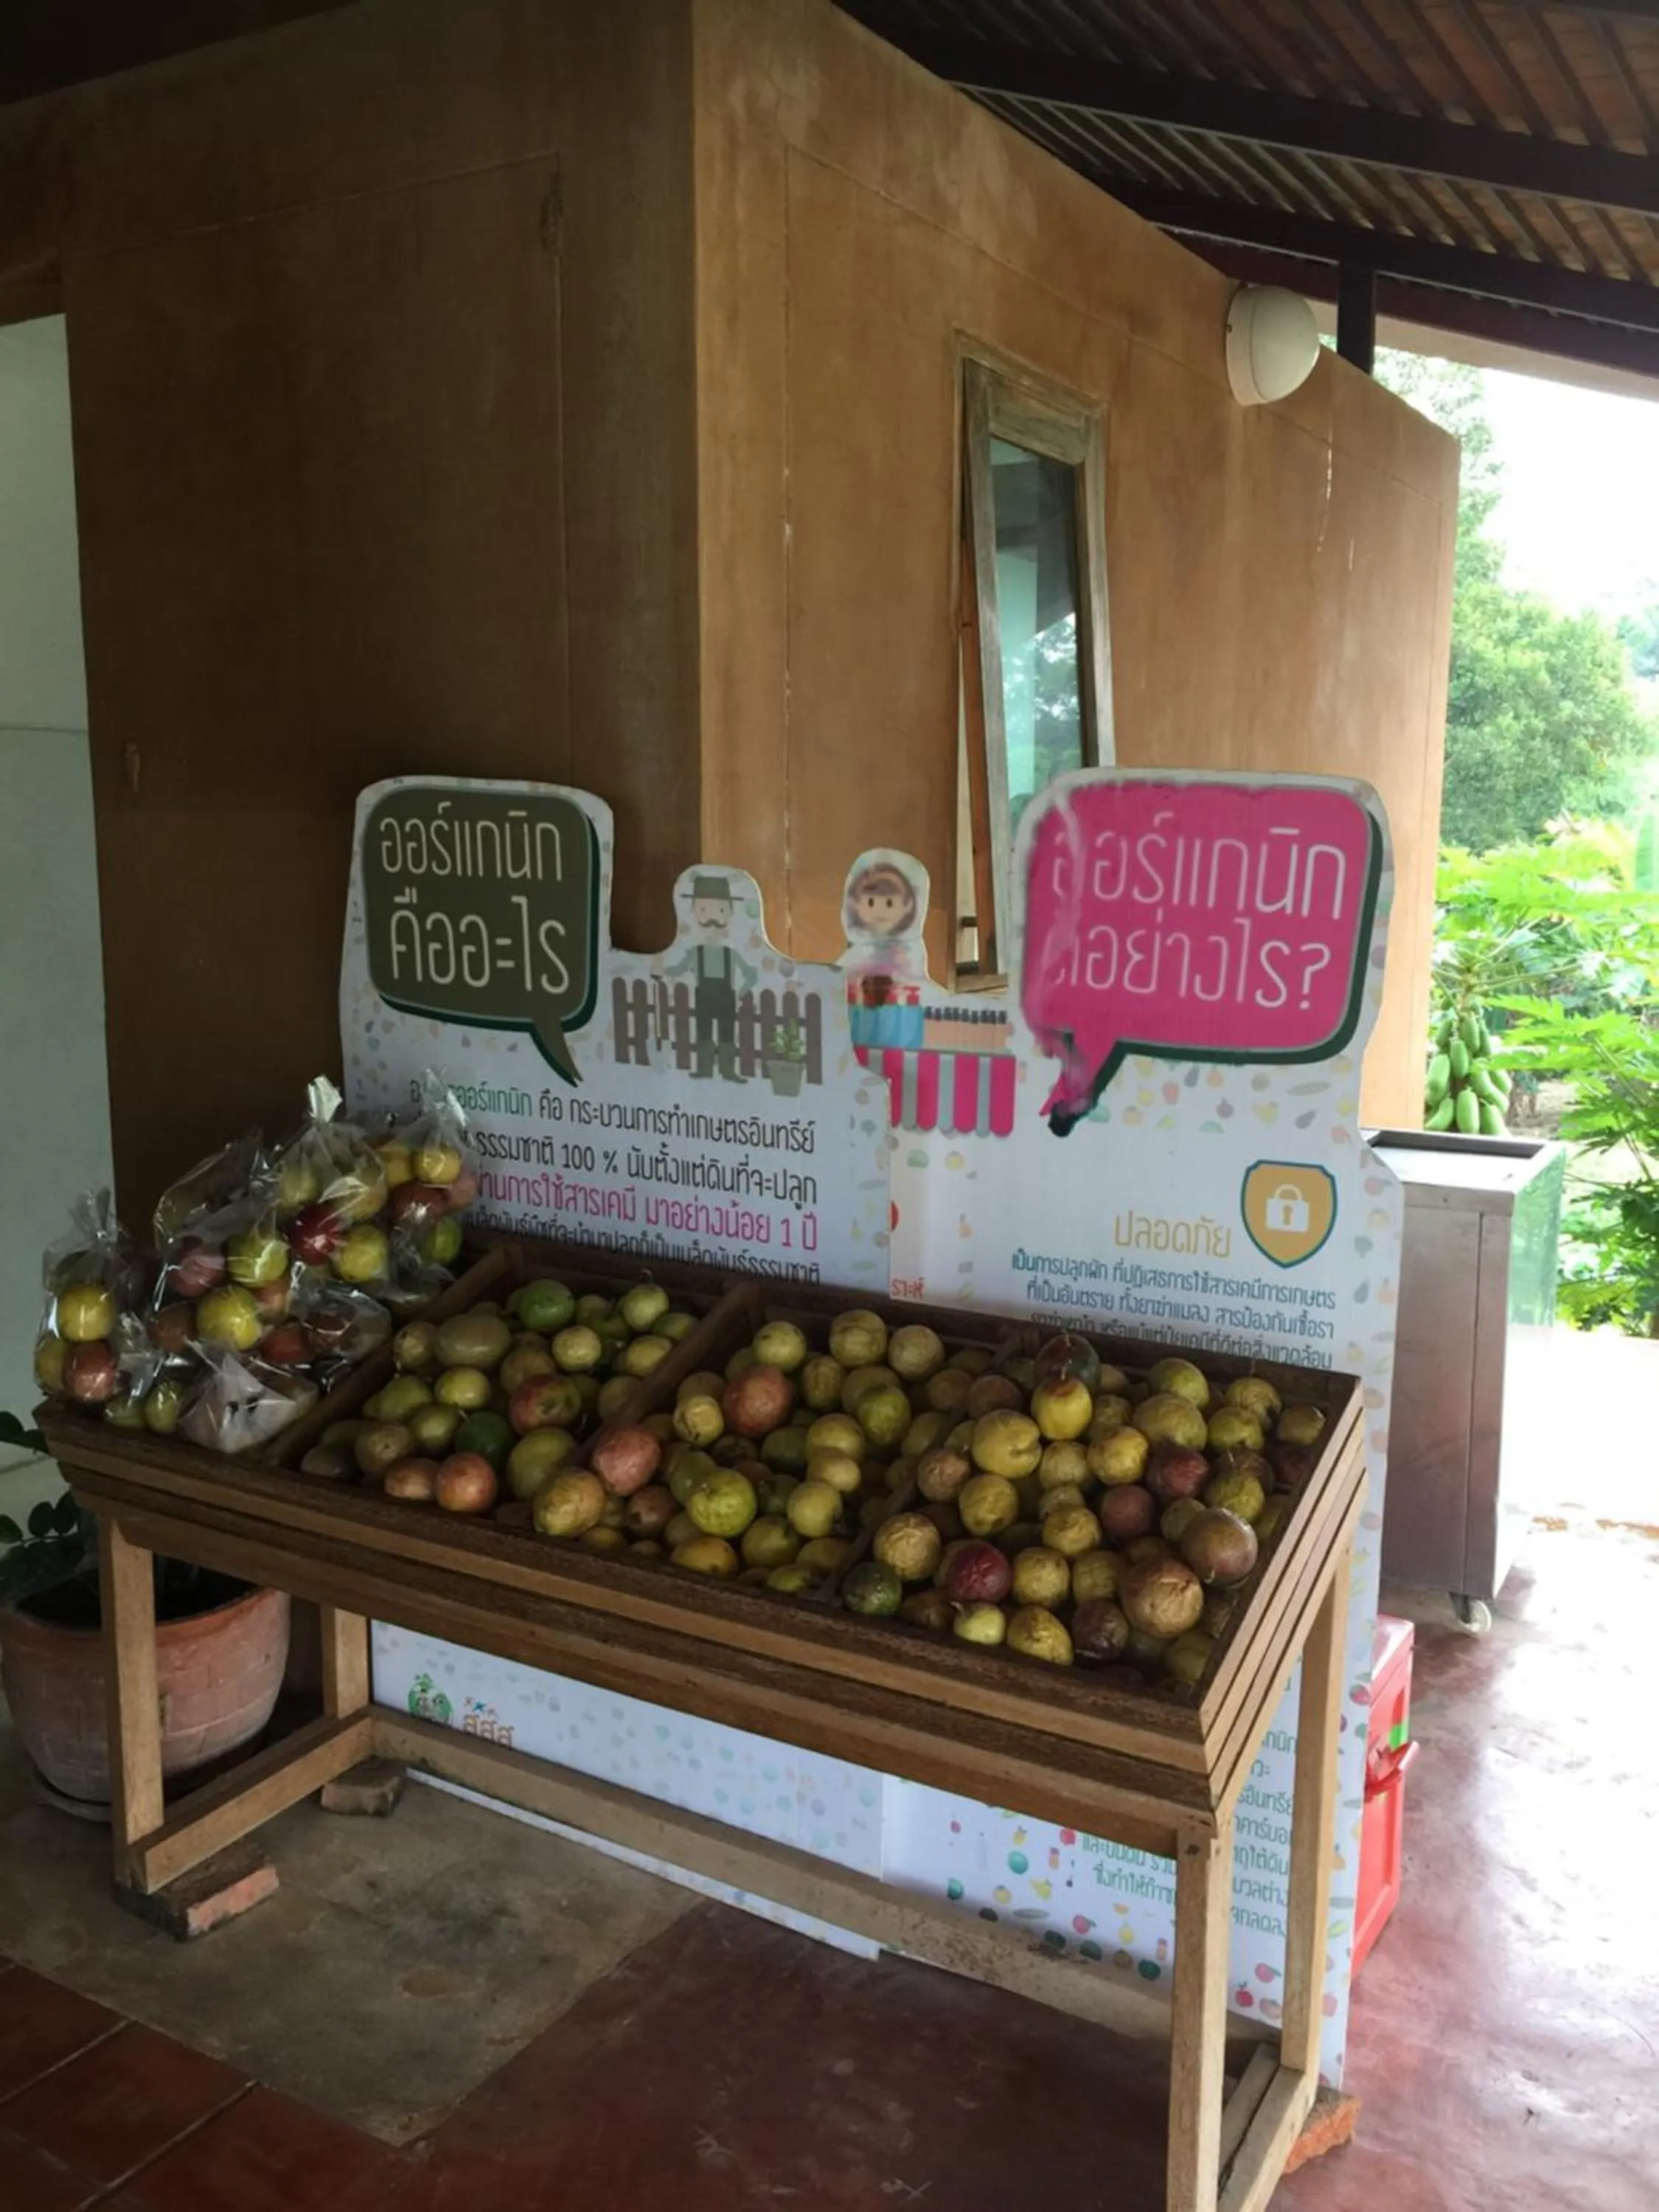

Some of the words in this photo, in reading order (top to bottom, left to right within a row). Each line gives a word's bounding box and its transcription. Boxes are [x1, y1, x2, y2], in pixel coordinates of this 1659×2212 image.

[390, 887, 570, 995] คืออะไร
[539, 1088, 563, 1121] คือ
[569, 1097, 816, 1154] กระบวนการทำเกษตรอินทรีย์
[460, 1129, 554, 1166] ธรรมชาติ
[561, 1143, 595, 1173] 100
[602, 1149, 619, 1175] %
[626, 1141, 817, 1211] นับตั้งแต่ดินที่จะปลูก
[646, 1189, 771, 1245] มาอย่างน้อย
[781, 1219, 792, 1248] 1
[801, 1211, 818, 1252] ปี
[1114, 1210, 1231, 1258] ปลอดภัย
